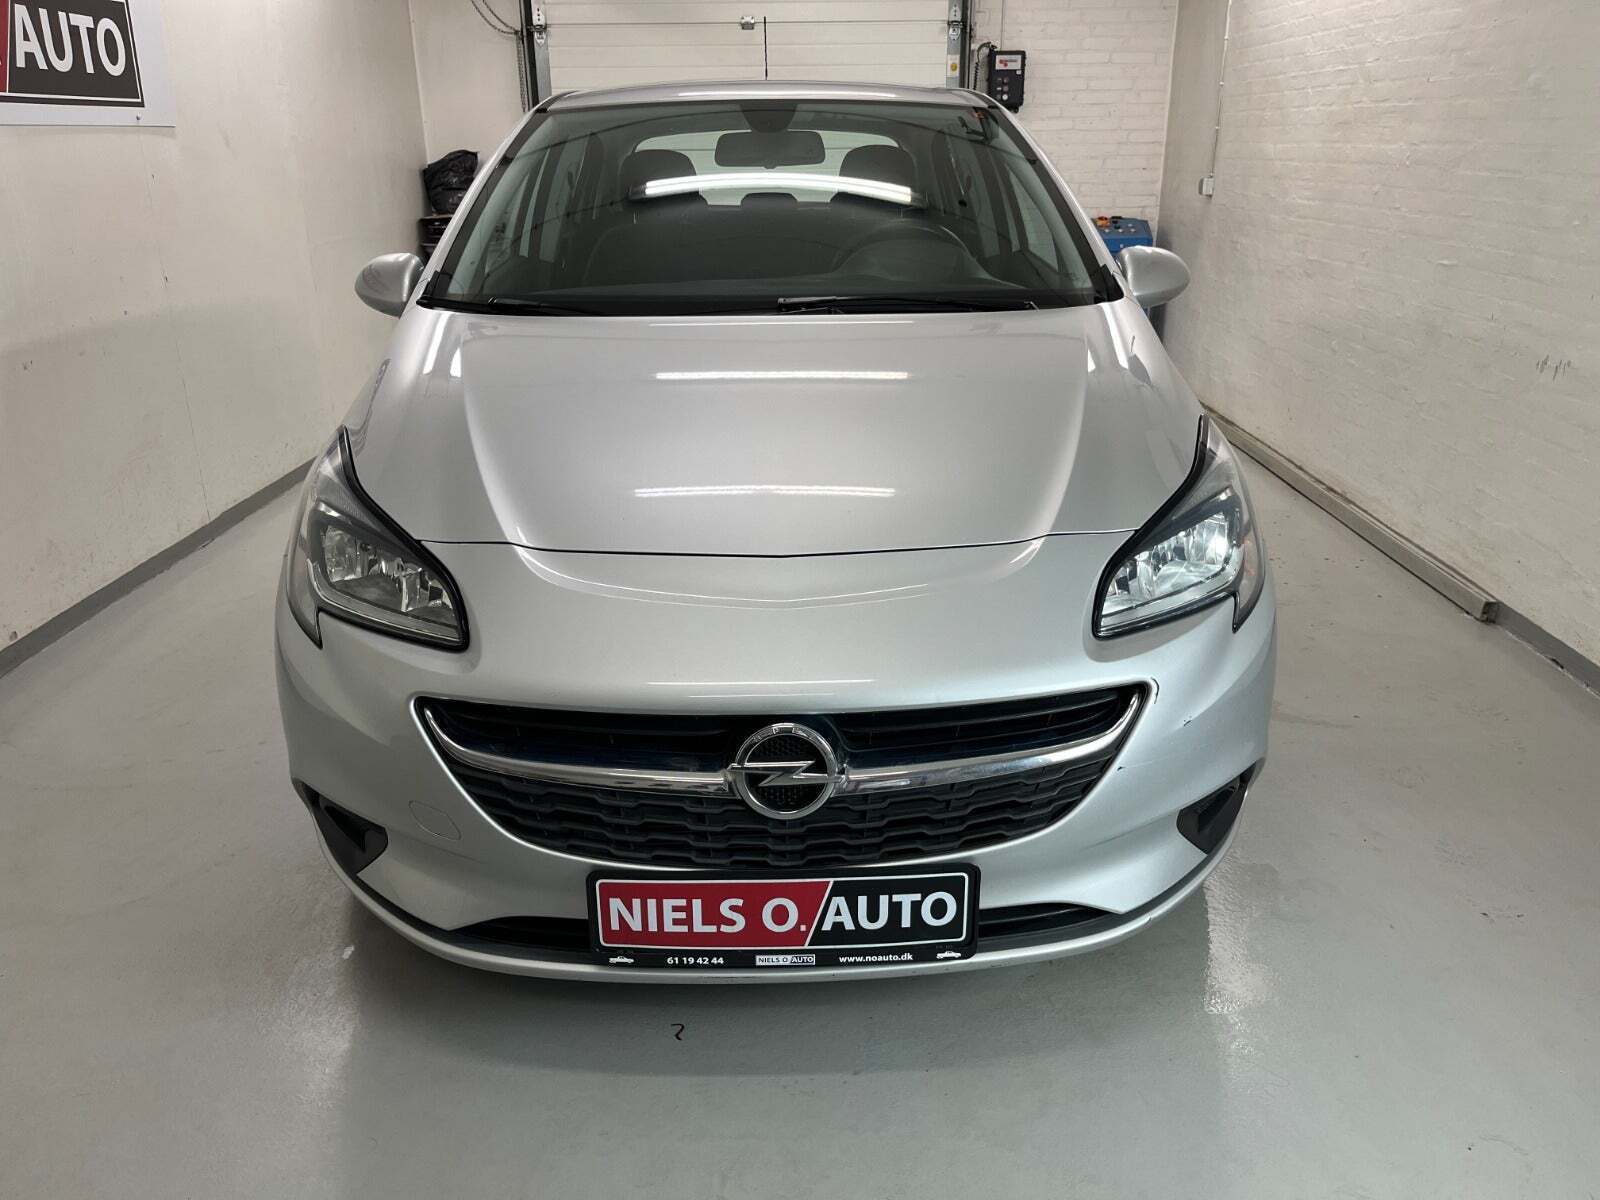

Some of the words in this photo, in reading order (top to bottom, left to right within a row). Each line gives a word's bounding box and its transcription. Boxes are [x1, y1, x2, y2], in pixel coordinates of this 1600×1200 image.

[14, 3, 126, 76] AUTO
[609, 897, 746, 933] NIELS
[761, 897, 807, 932] O.
[820, 891, 957, 932] AUTO
[666, 956, 679, 965] 61
[682, 956, 695, 965] 19
[696, 956, 710, 965] 42
[711, 956, 725, 965] 44
[758, 956, 781, 964] NIELS
[790, 956, 814, 964] AUTO
[838, 952, 914, 963] www.noauto.dk
